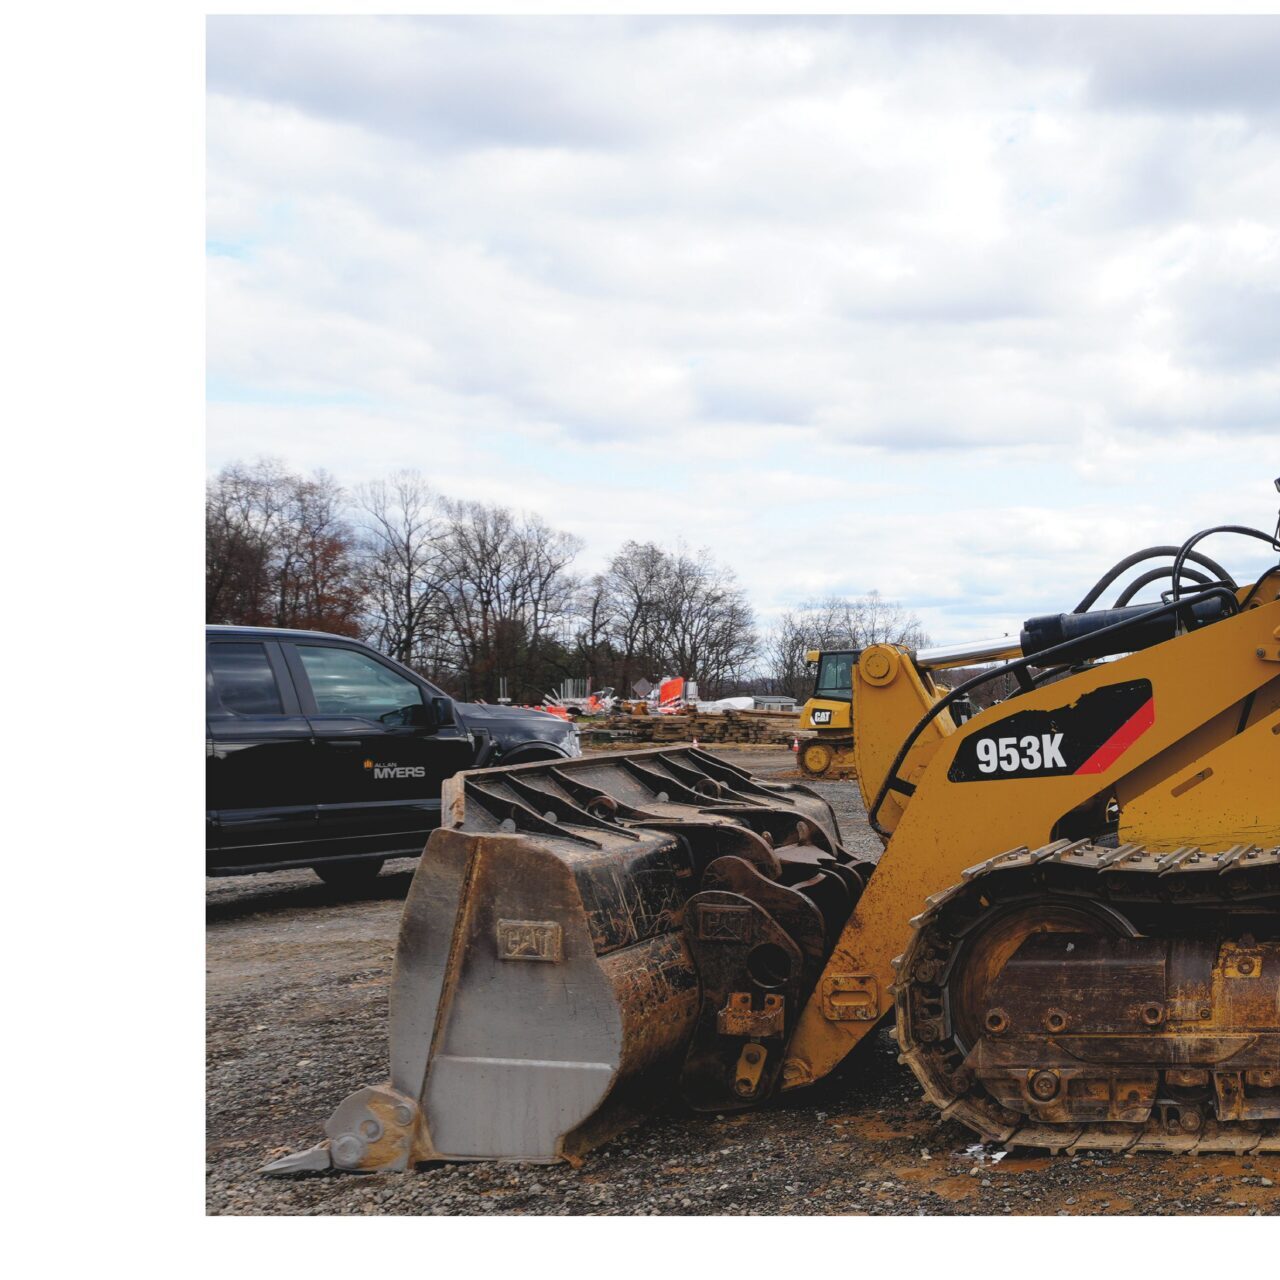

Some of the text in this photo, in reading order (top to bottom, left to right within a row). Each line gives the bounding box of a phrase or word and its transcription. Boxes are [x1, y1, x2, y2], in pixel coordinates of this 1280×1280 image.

[814, 711, 831, 723] CAT
[976, 733, 1067, 773] 953K
[374, 766, 426, 779] MYERS
